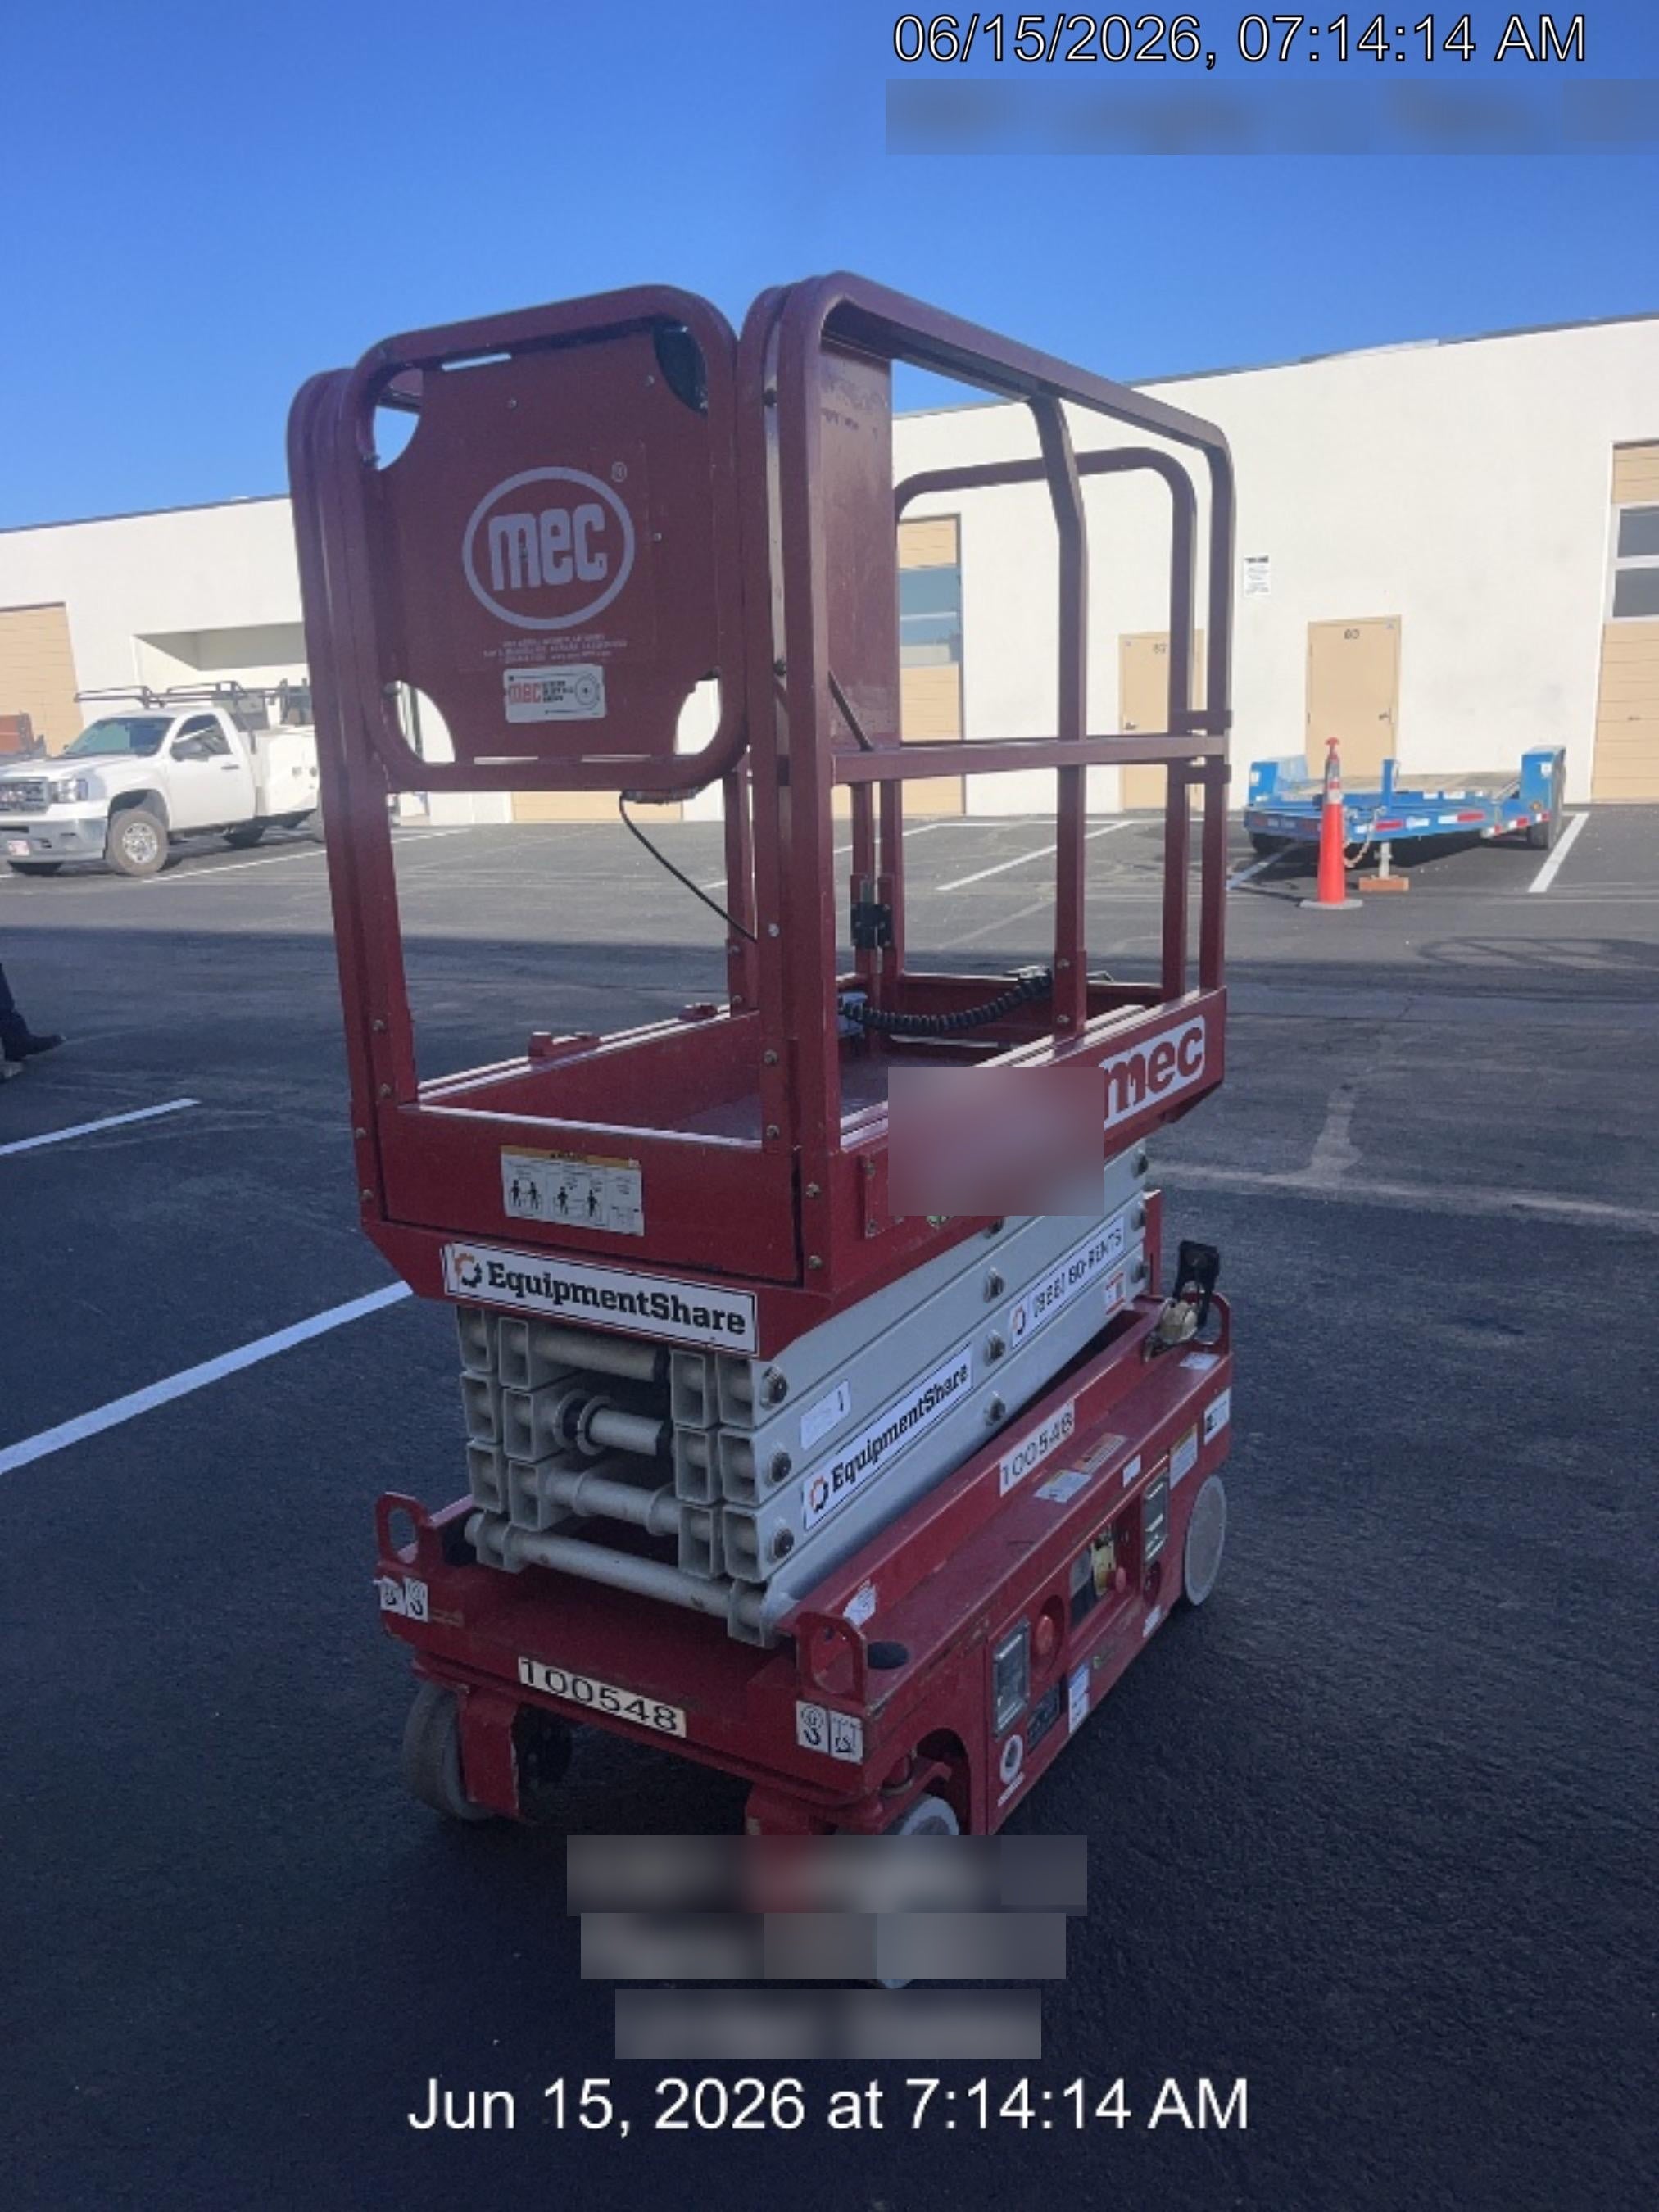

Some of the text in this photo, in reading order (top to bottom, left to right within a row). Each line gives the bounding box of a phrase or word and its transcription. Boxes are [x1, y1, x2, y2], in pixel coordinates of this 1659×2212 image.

[487, 1260, 746, 1335] EquipmentShare
[831, 1363, 969, 1493] EquipmentShare
[1001, 1412, 1072, 1485] 100548
[520, 1659, 677, 1731] 100548
